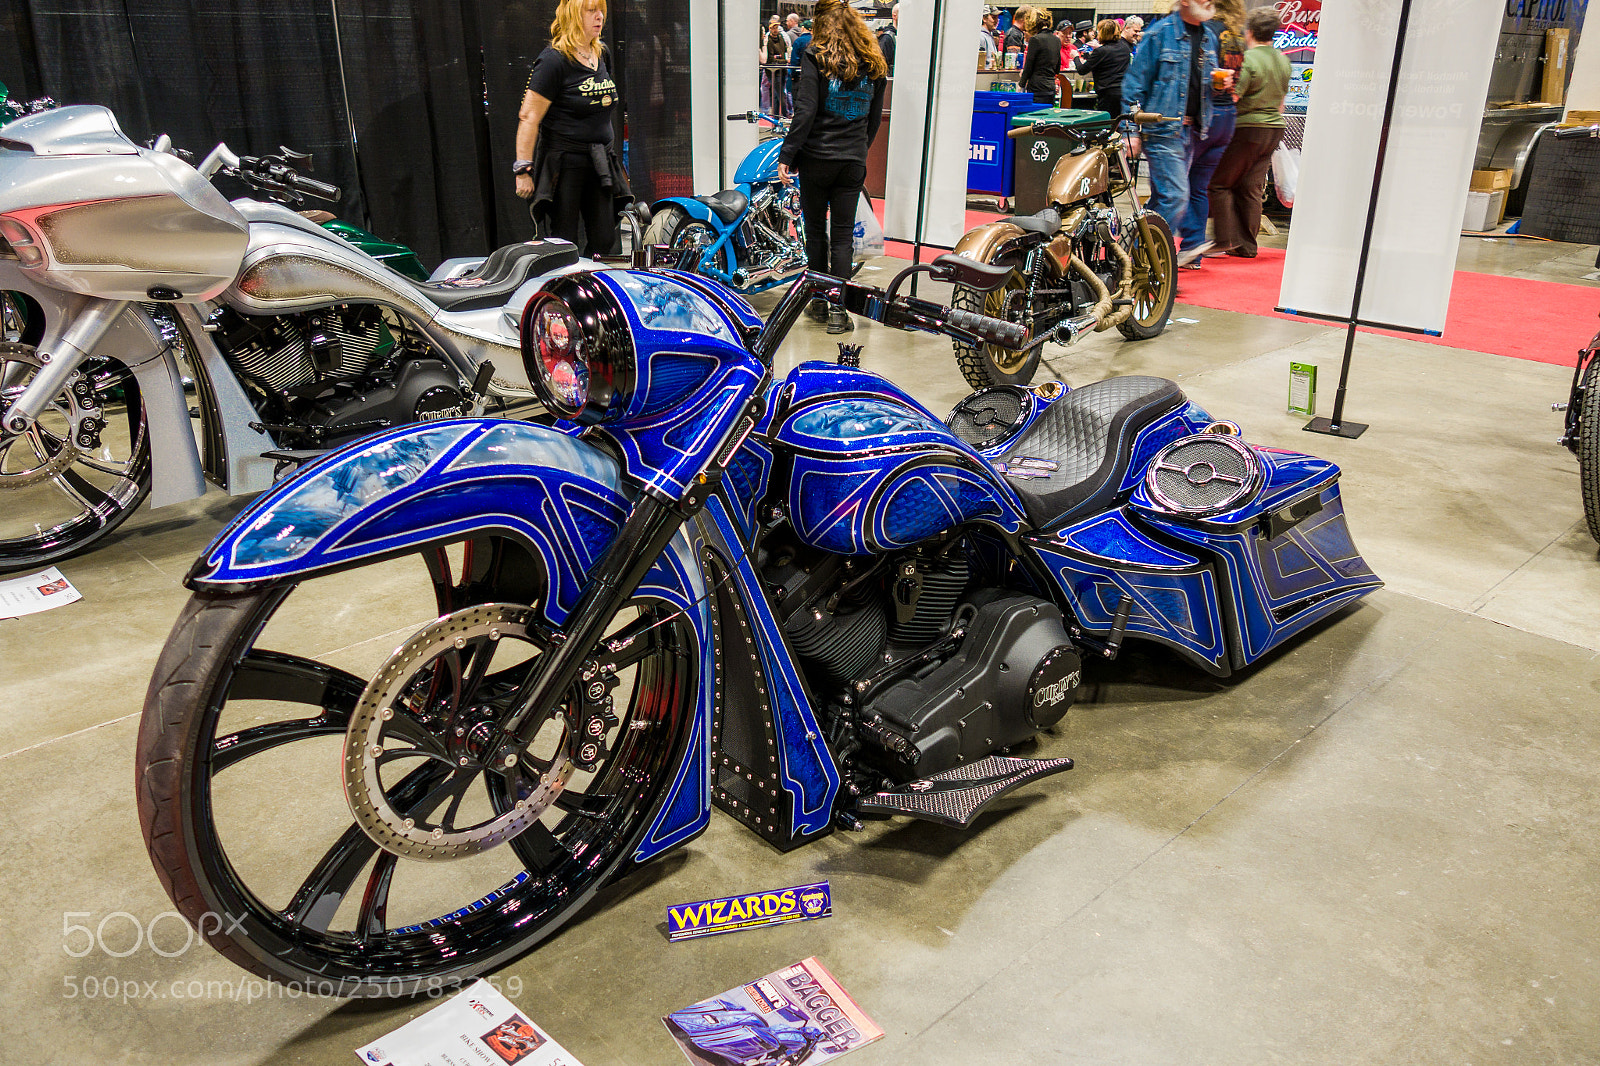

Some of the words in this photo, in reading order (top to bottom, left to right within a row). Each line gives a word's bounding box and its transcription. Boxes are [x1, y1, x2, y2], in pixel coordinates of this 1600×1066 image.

[1080, 177, 1091, 196] 18
[669, 890, 797, 930] WIZARDS
[784, 971, 862, 1051] BAGGER
